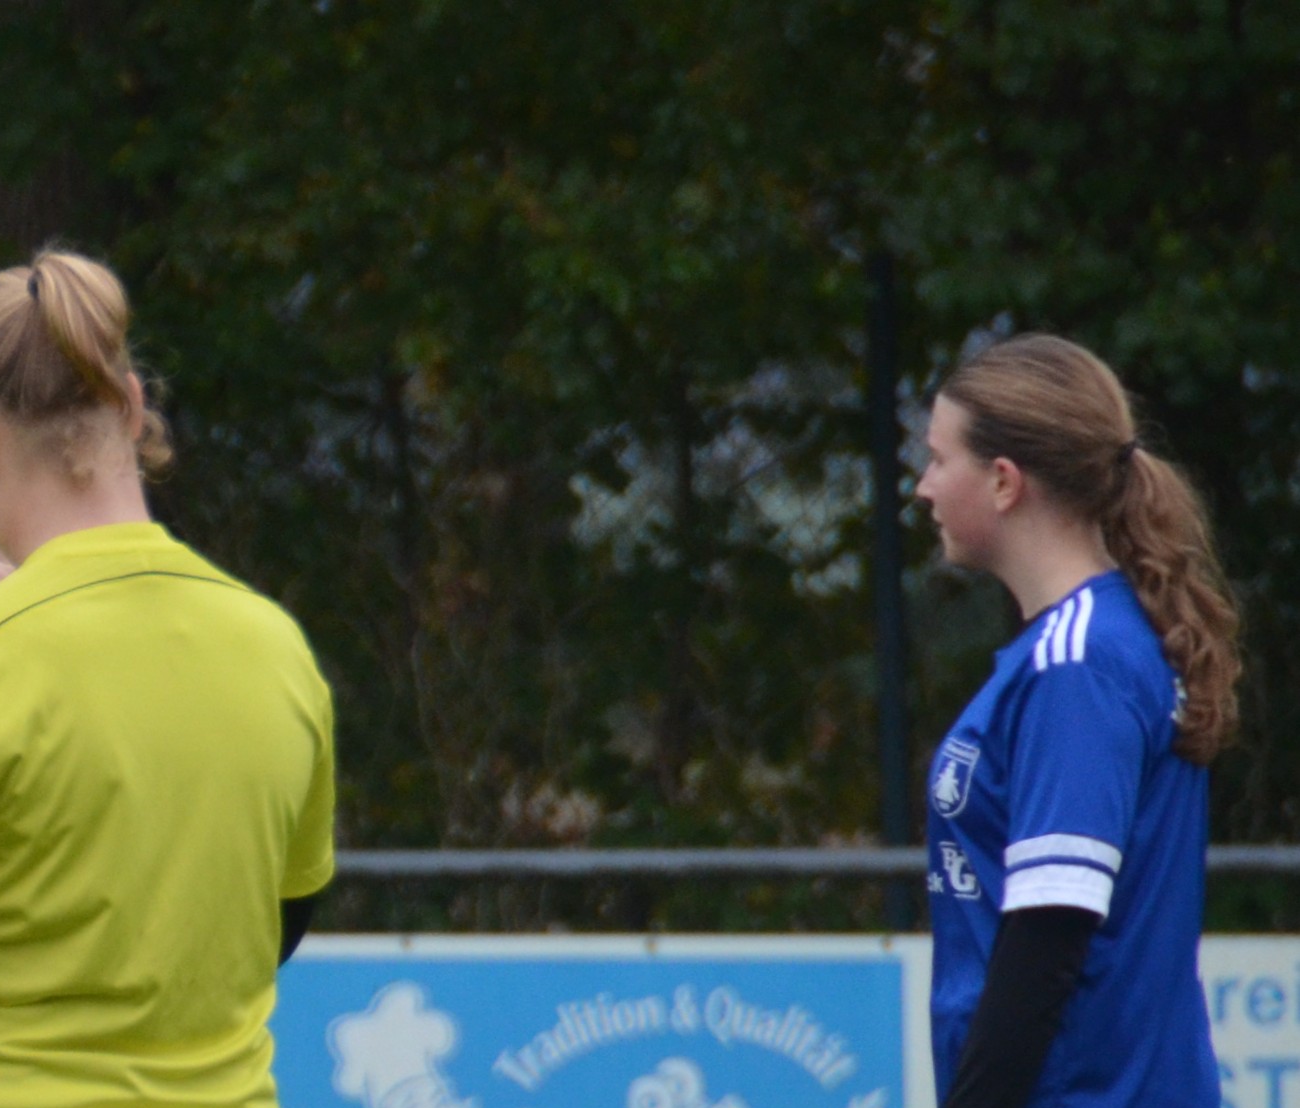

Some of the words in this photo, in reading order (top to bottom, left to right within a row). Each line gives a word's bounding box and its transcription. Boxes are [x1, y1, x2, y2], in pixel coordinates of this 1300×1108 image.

[493, 993, 666, 1090] Tradition
[671, 984, 698, 1036] &
[705, 986, 856, 1090] Qualität
